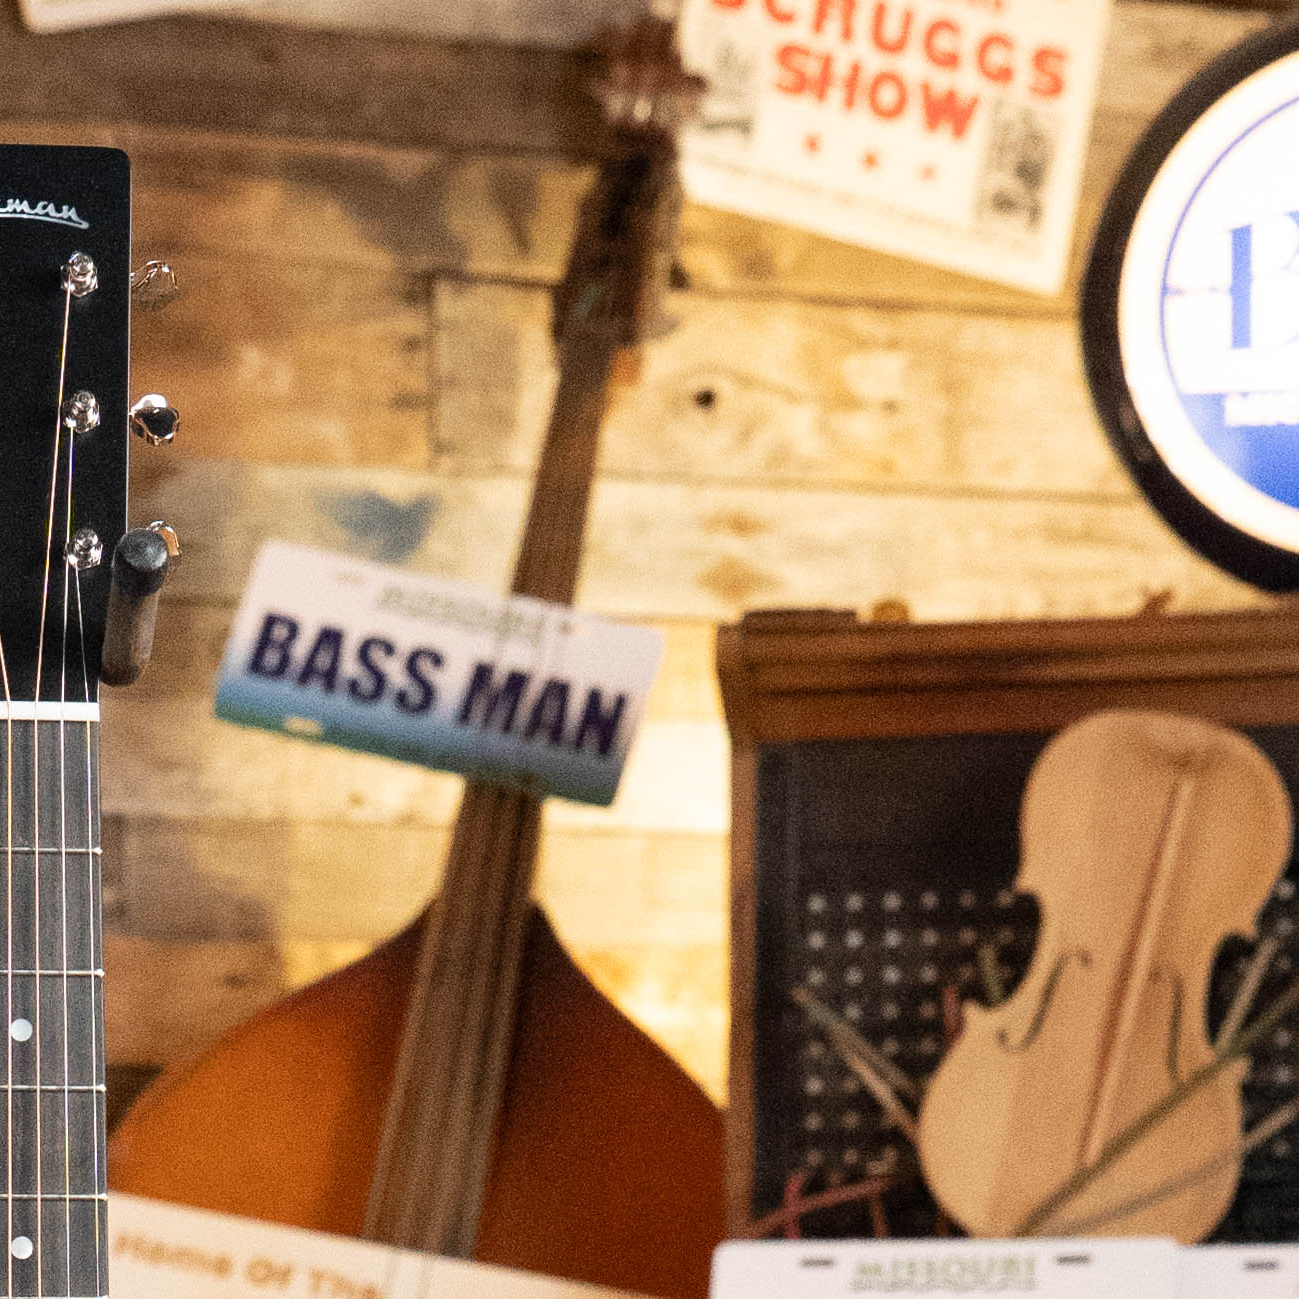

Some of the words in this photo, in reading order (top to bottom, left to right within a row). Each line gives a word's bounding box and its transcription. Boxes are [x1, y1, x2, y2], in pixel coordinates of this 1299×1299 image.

[705, 0, 1066, 98] RUGGS
[775, 43, 981, 140] SHOW
[248, 611, 444, 716] BASS
[456, 658, 627, 757] MAN
